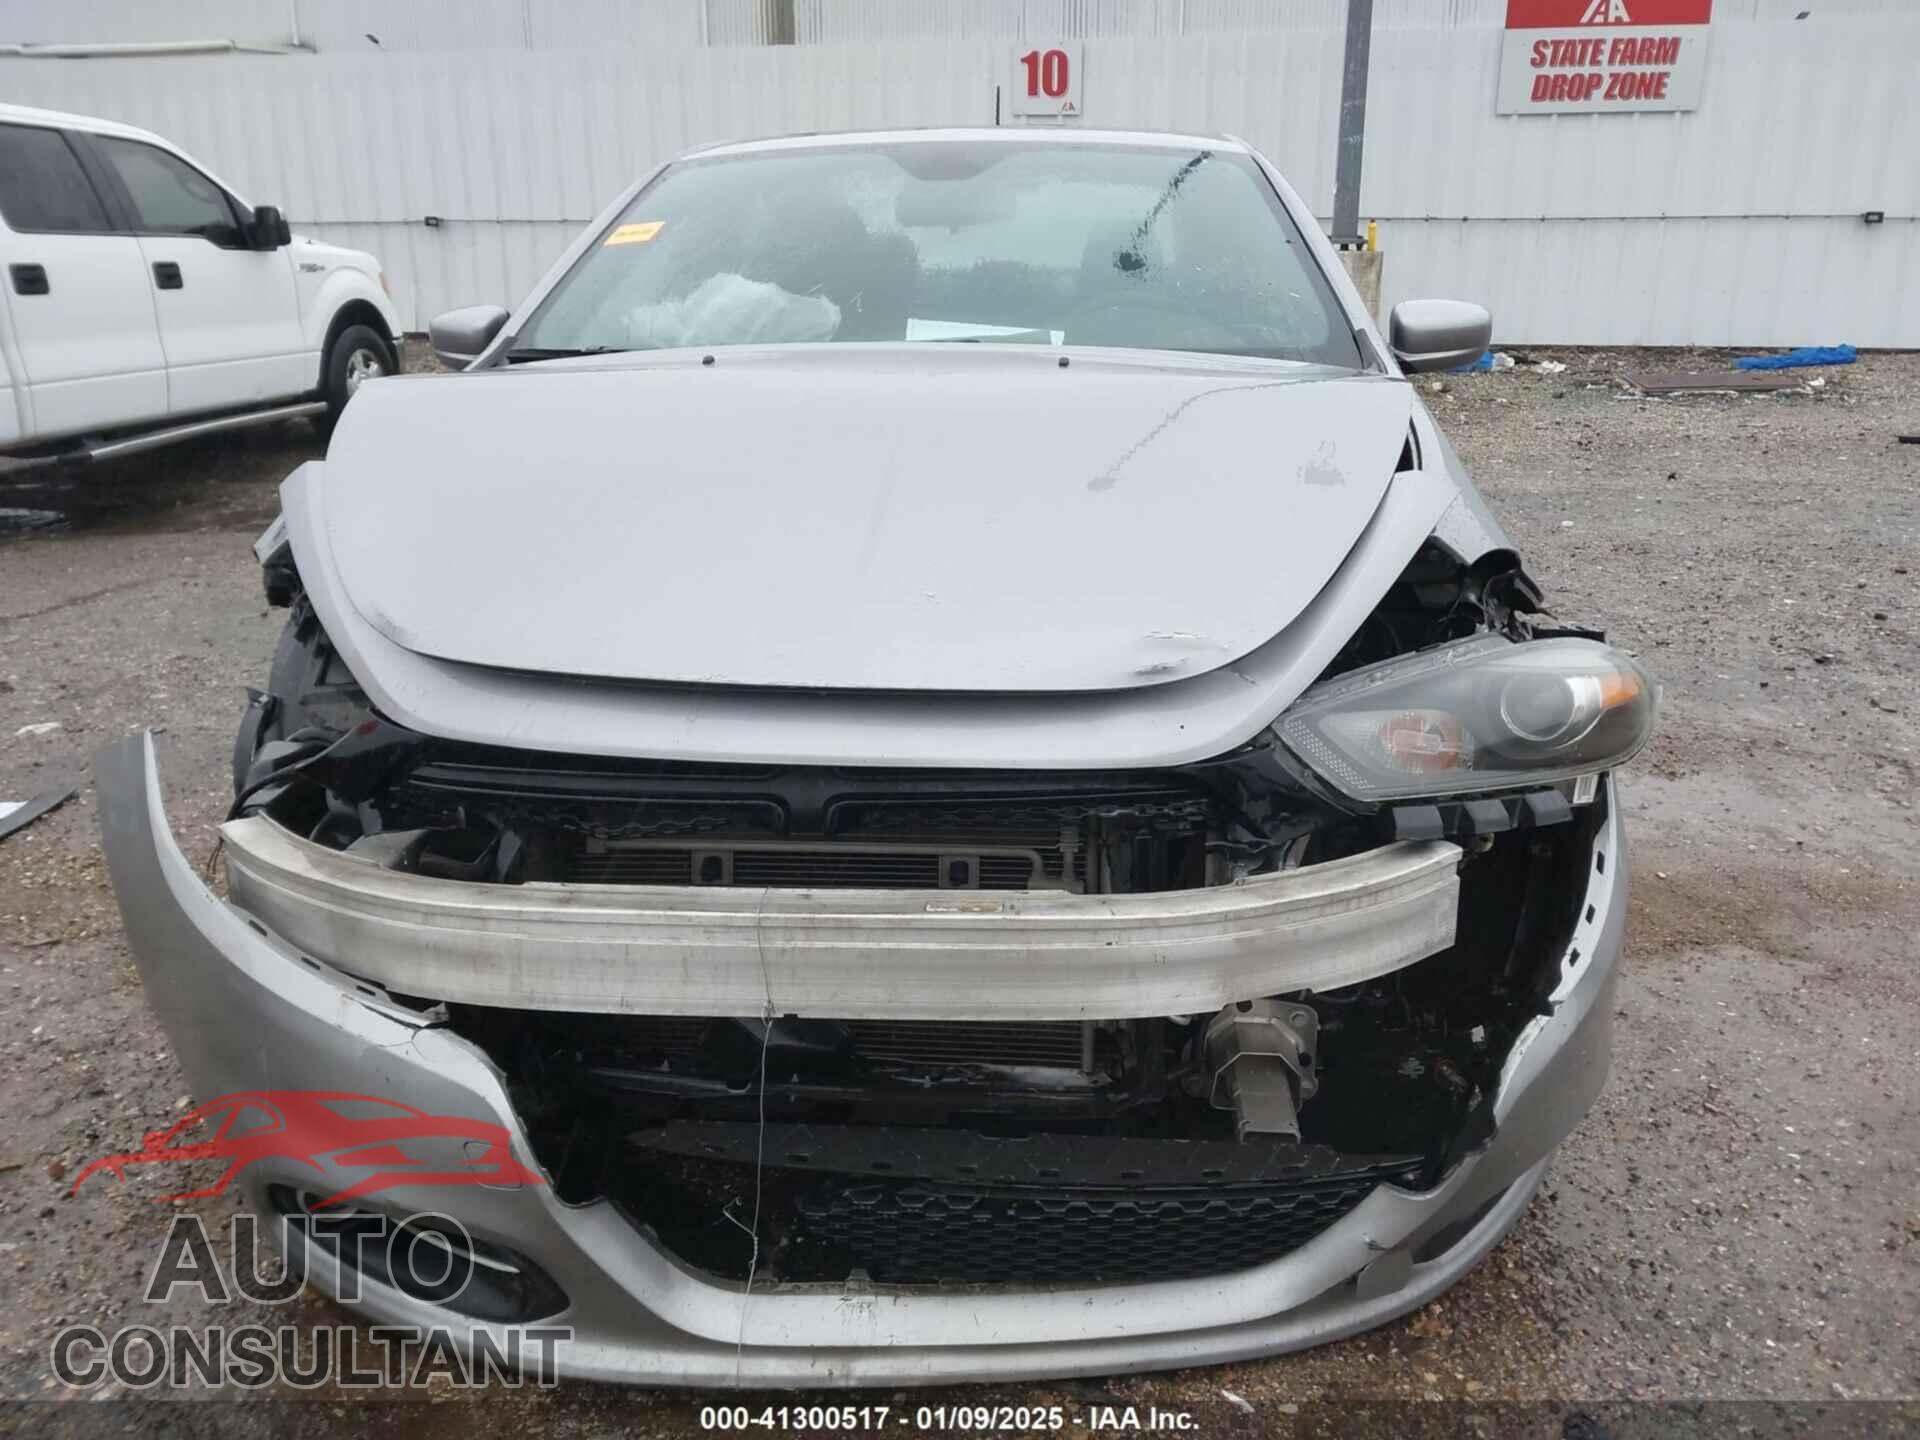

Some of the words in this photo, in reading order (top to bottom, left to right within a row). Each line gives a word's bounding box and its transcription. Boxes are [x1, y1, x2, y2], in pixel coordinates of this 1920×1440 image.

[1530, 38, 1606, 68] STATE
[1607, 36, 1681, 65] FARM
[1020, 49, 1068, 97] 10
[1531, 73, 1604, 102] DROP
[1603, 71, 1671, 101] ZONE
